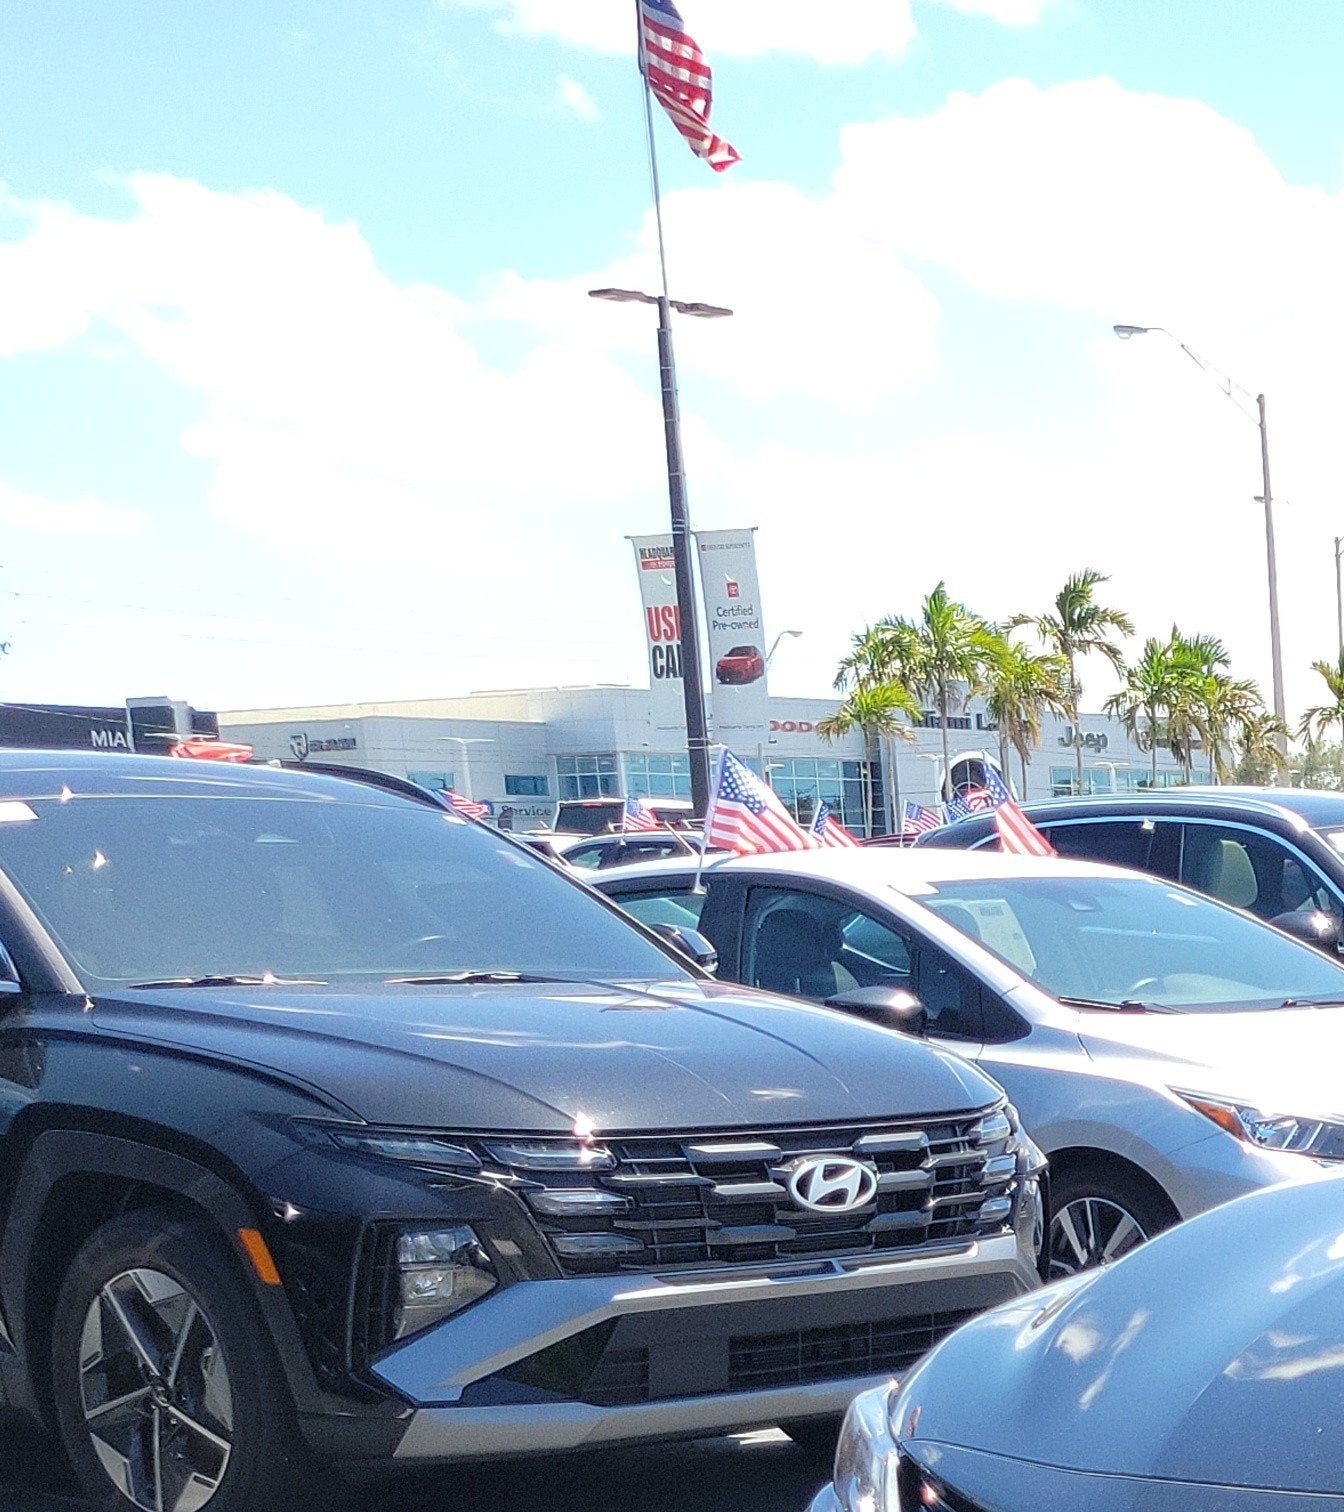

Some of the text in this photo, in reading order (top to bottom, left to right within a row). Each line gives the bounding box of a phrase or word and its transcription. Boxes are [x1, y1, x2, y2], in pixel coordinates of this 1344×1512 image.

[716, 604, 753, 618] Certified
[712, 617, 760, 631] Pre-owned
[1057, 725, 1109, 753] Jeep
